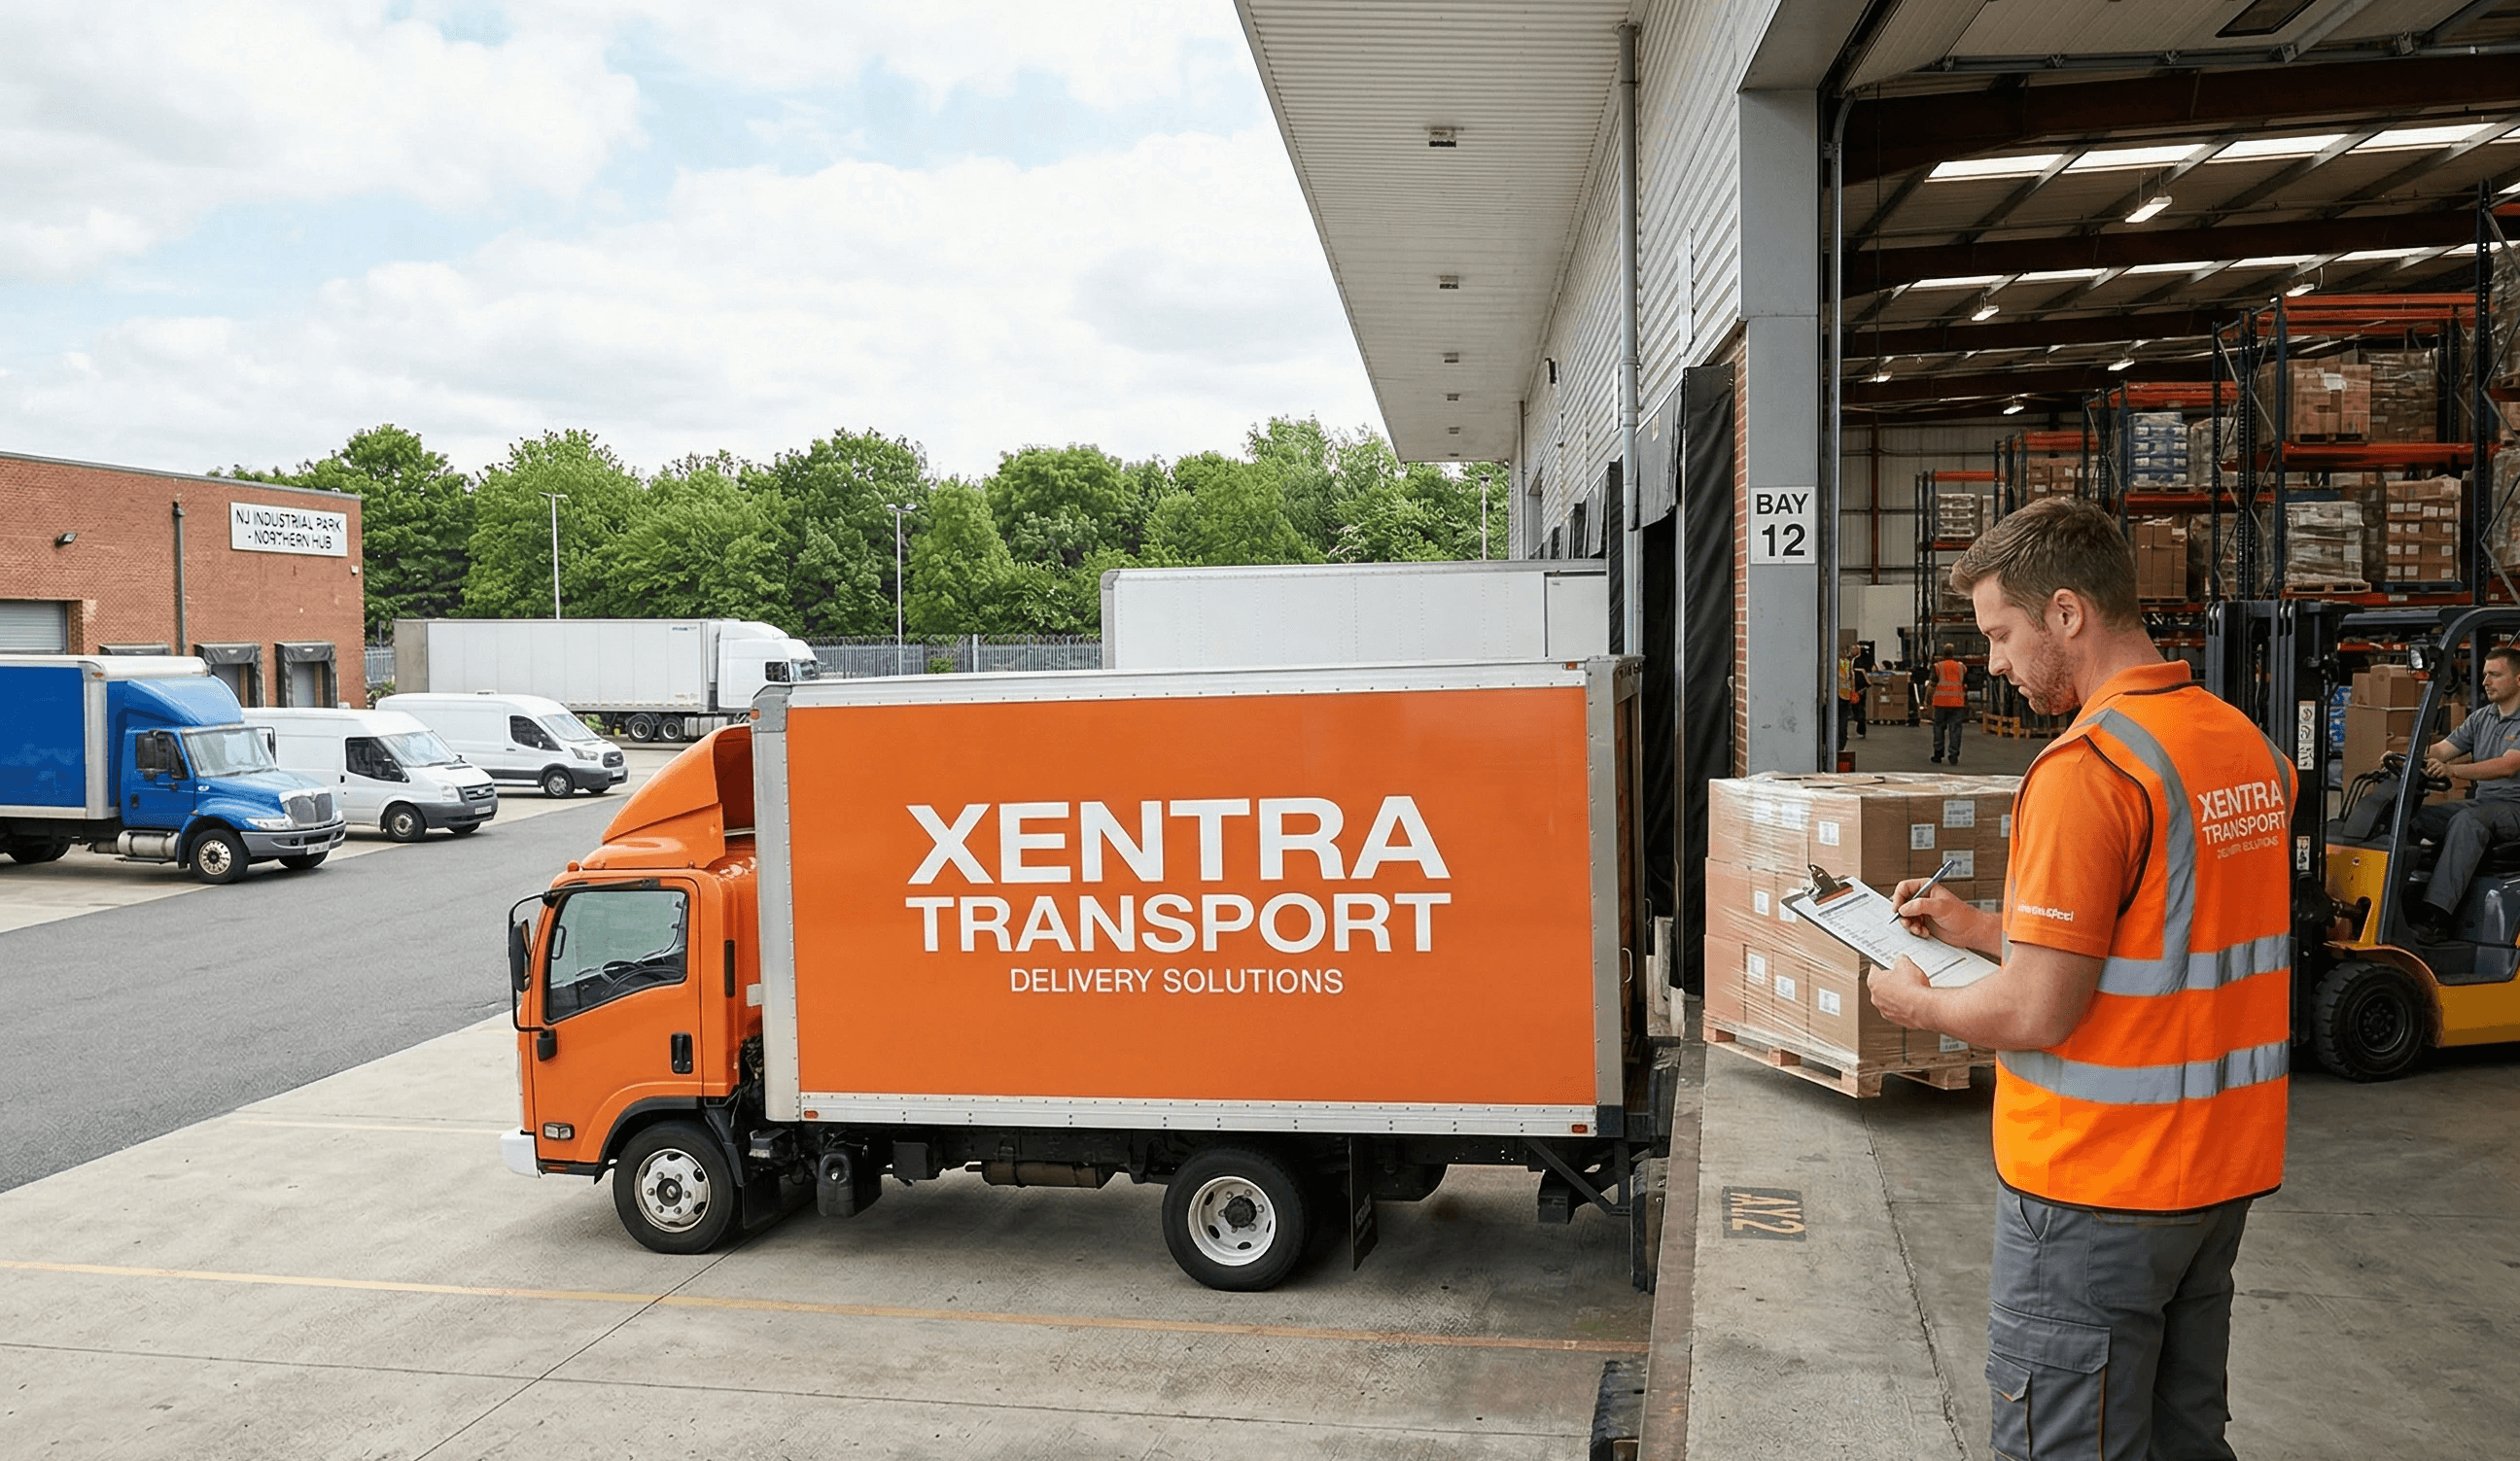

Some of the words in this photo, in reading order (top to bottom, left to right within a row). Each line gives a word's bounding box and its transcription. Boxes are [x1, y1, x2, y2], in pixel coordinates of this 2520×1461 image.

[1756, 493, 1808, 514] BAY
[236, 509, 250, 524] NJ
[254, 511, 314, 531] INDUSTRIAL
[316, 517, 342, 533] PARK
[312, 534, 332, 549] HUB
[1762, 523, 1805, 557] 12
[2197, 780, 2284, 823] XENTRA
[906, 795, 1452, 885] XENTRA
[2202, 811, 2286, 846] TRANSPORT
[905, 892, 1452, 954] TRANSPORT
[1010, 968, 1154, 992] DELIVERY
[1163, 968, 1344, 994] SOLUTIONS
